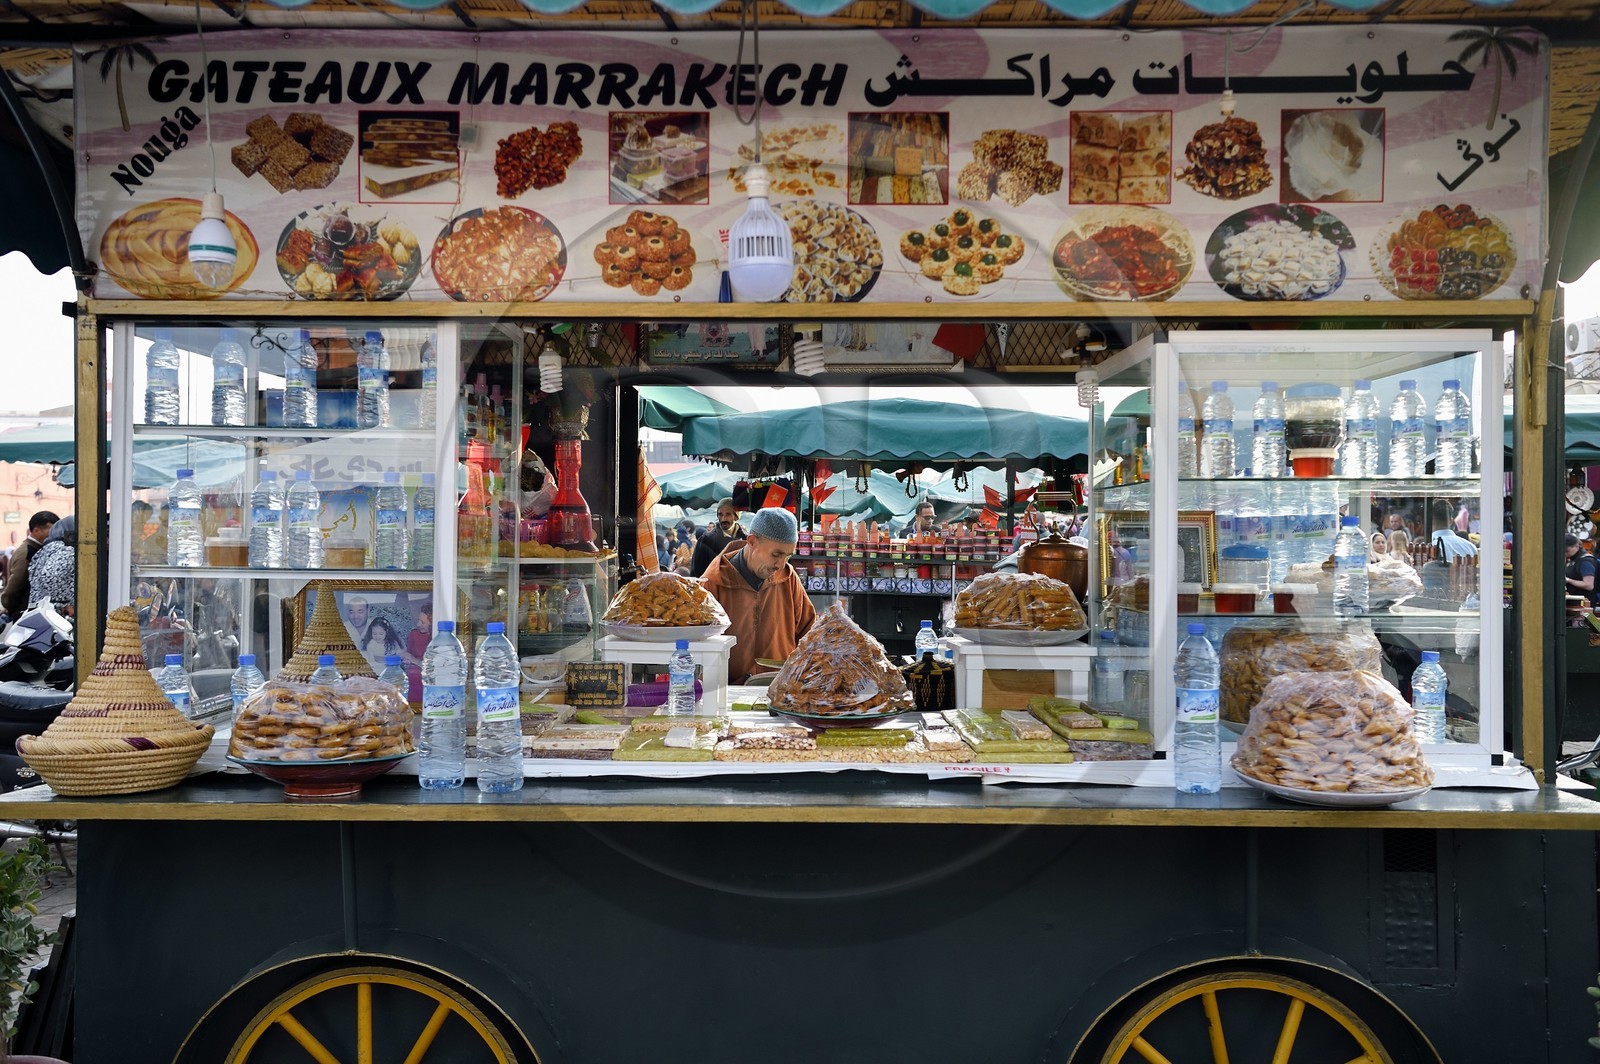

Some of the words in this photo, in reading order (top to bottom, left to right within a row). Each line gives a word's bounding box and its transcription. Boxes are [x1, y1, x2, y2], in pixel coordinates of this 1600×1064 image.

[148, 60, 431, 105] GATEAUX
[447, 61, 848, 109] MARRAKECH
[864, 53, 1116, 107] مراكش
[1133, 50, 1475, 104] حلويات
[109, 102, 201, 196] Nouga
